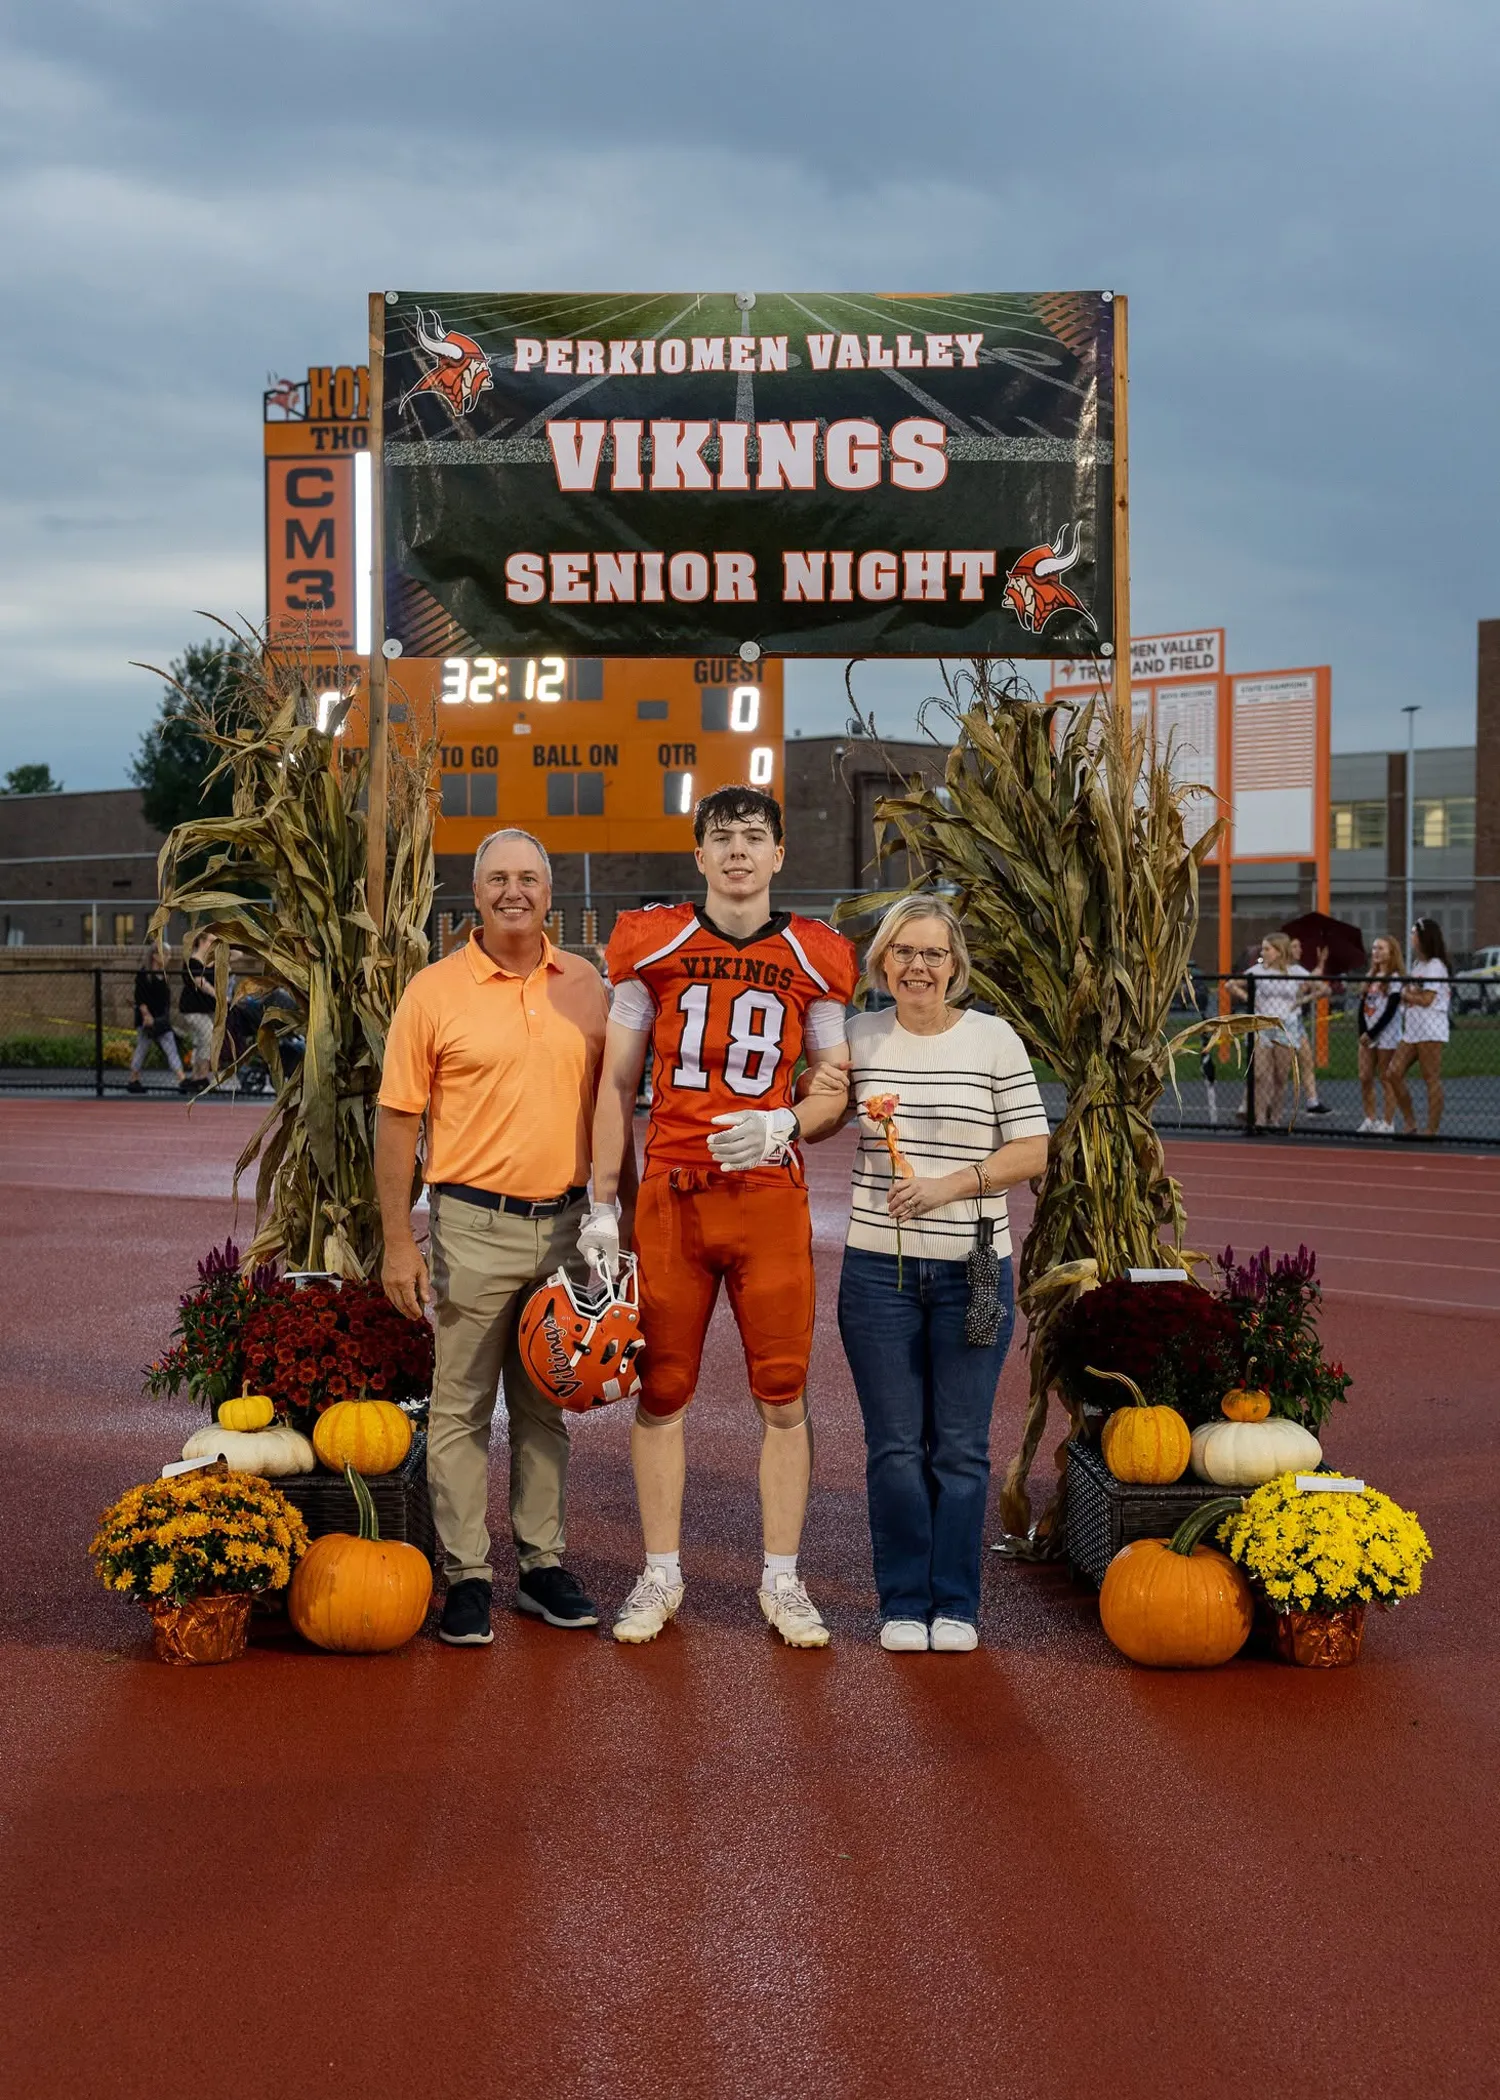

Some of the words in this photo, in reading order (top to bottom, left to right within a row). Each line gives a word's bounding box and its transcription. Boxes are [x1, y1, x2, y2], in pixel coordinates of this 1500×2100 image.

[513, 336, 788, 375] PERKIOMEN
[806, 333, 984, 371] VALLEY
[545, 418, 948, 492] VIKINGS
[504, 551, 758, 604] SENIOR
[782, 550, 997, 602] NIGHT
[1132, 660, 1165, 675] AND
[1169, 654, 1215, 672] FIELD
[1160, 637, 1215, 654] VALLEY
[441, 656, 567, 704] 32:12
[693, 658, 767, 684] GUEST
[730, 686, 760, 732] 0
[440, 745, 464, 768] TO
[470, 745, 499, 768] GO
[532, 745, 583, 768] BALL
[589, 744, 619, 767] ON
[658, 743, 697, 769] QTR
[750, 747, 774, 786] 0
[680, 956, 795, 991] VIKINGS
[671, 982, 788, 1099] 18
[542, 1317, 585, 1399] Vikings
